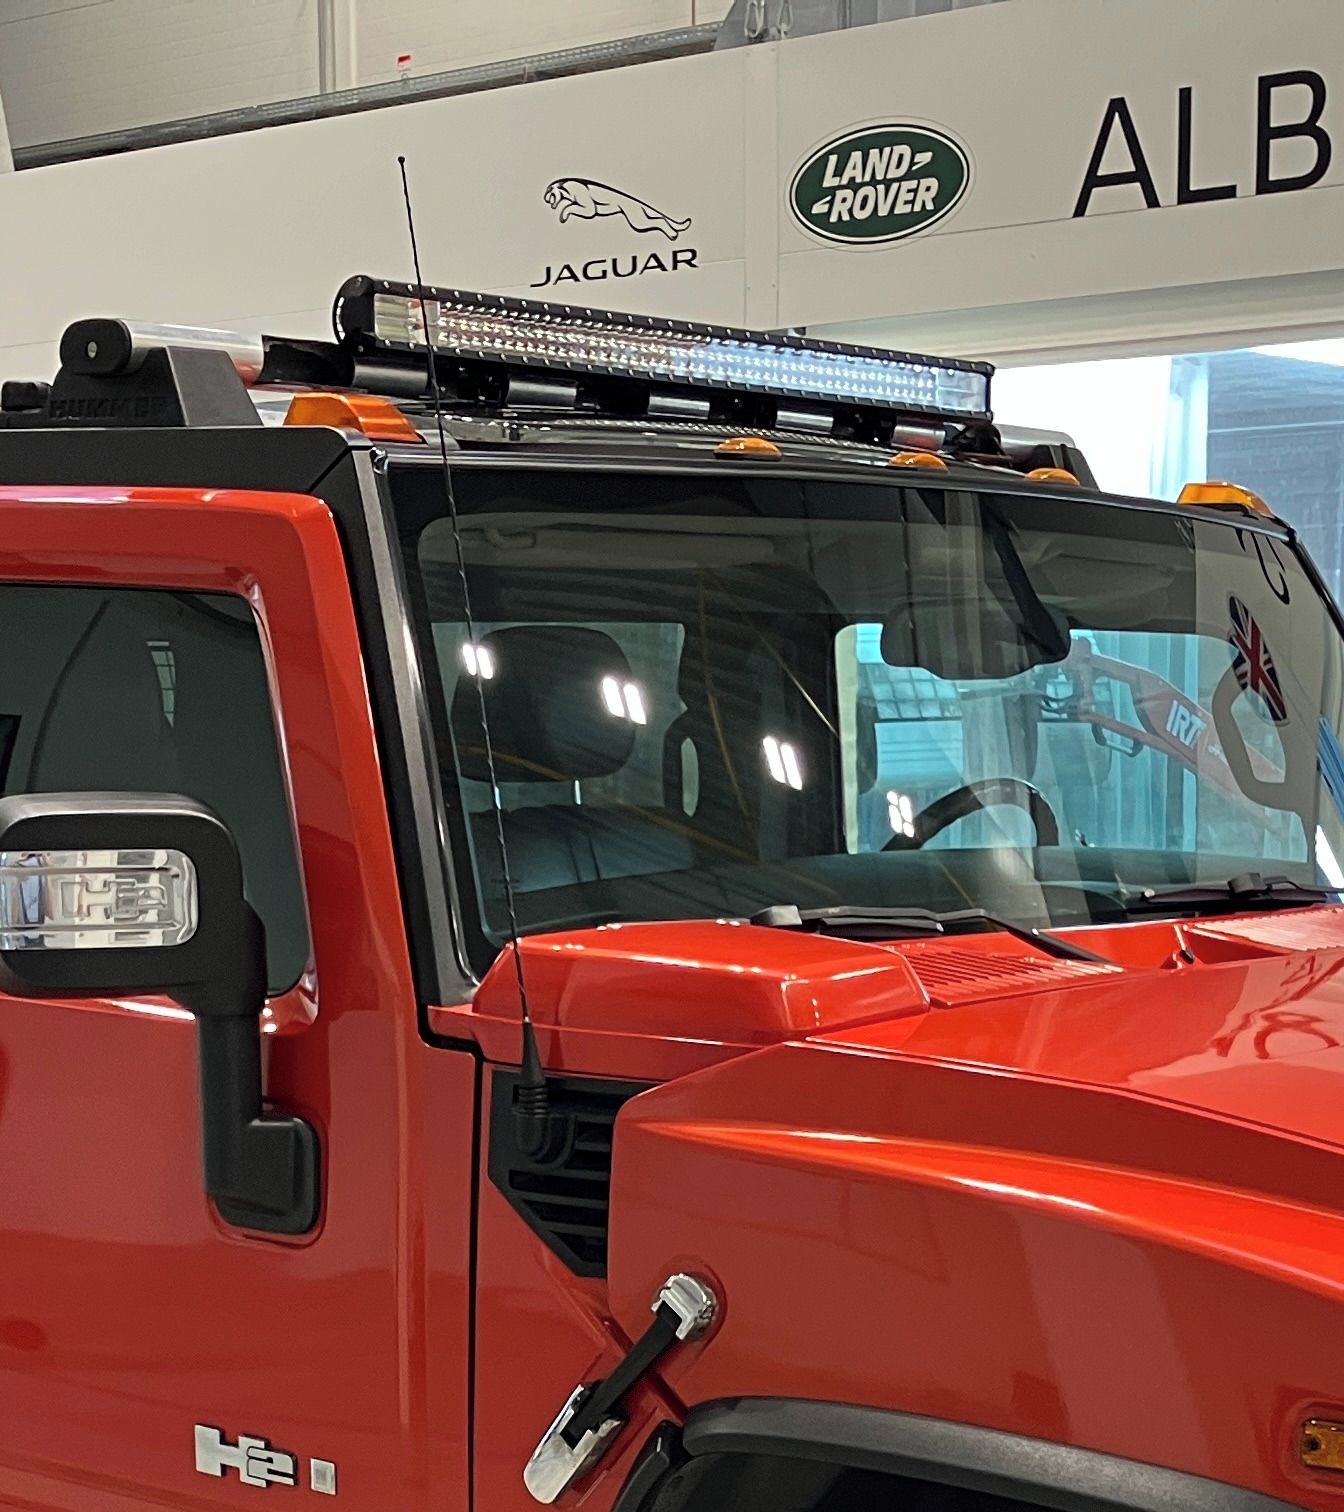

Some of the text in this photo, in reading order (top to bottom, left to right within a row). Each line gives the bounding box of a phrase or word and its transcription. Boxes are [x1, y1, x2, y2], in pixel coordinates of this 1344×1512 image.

[829, 177, 939, 222] ROVER
[530, 247, 699, 288] JAGUAR
[1167, 701, 1207, 749] IRT
[195, 1424, 295, 1488] H2
